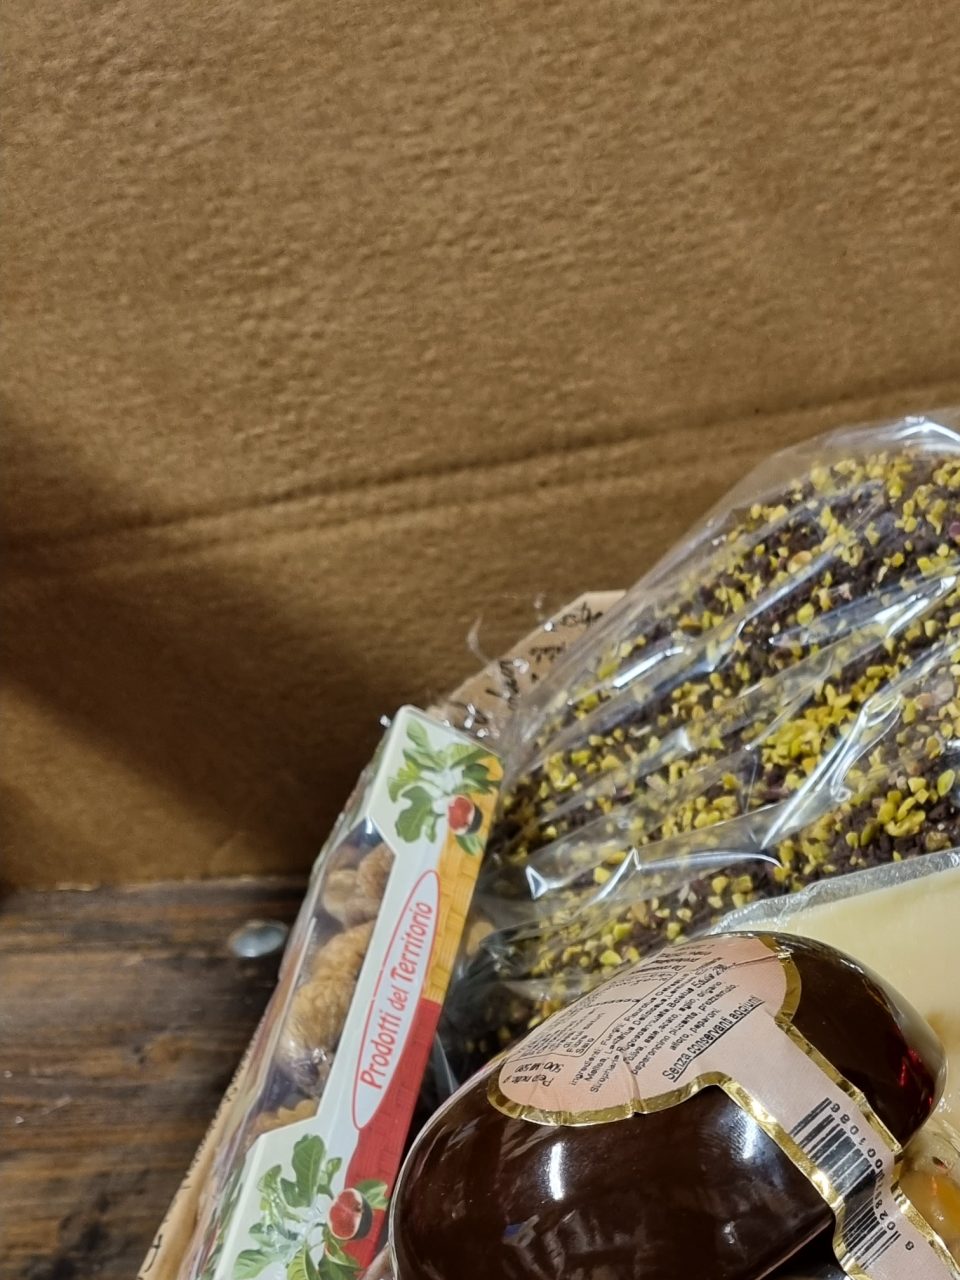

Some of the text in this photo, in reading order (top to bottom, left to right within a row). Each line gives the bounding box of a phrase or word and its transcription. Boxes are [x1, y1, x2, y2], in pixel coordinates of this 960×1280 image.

[360, 901, 432, 1090] Prodotti del Territorio
[662, 1052, 691, 1080] Senza
[686, 1016, 733, 1054] conservanti
